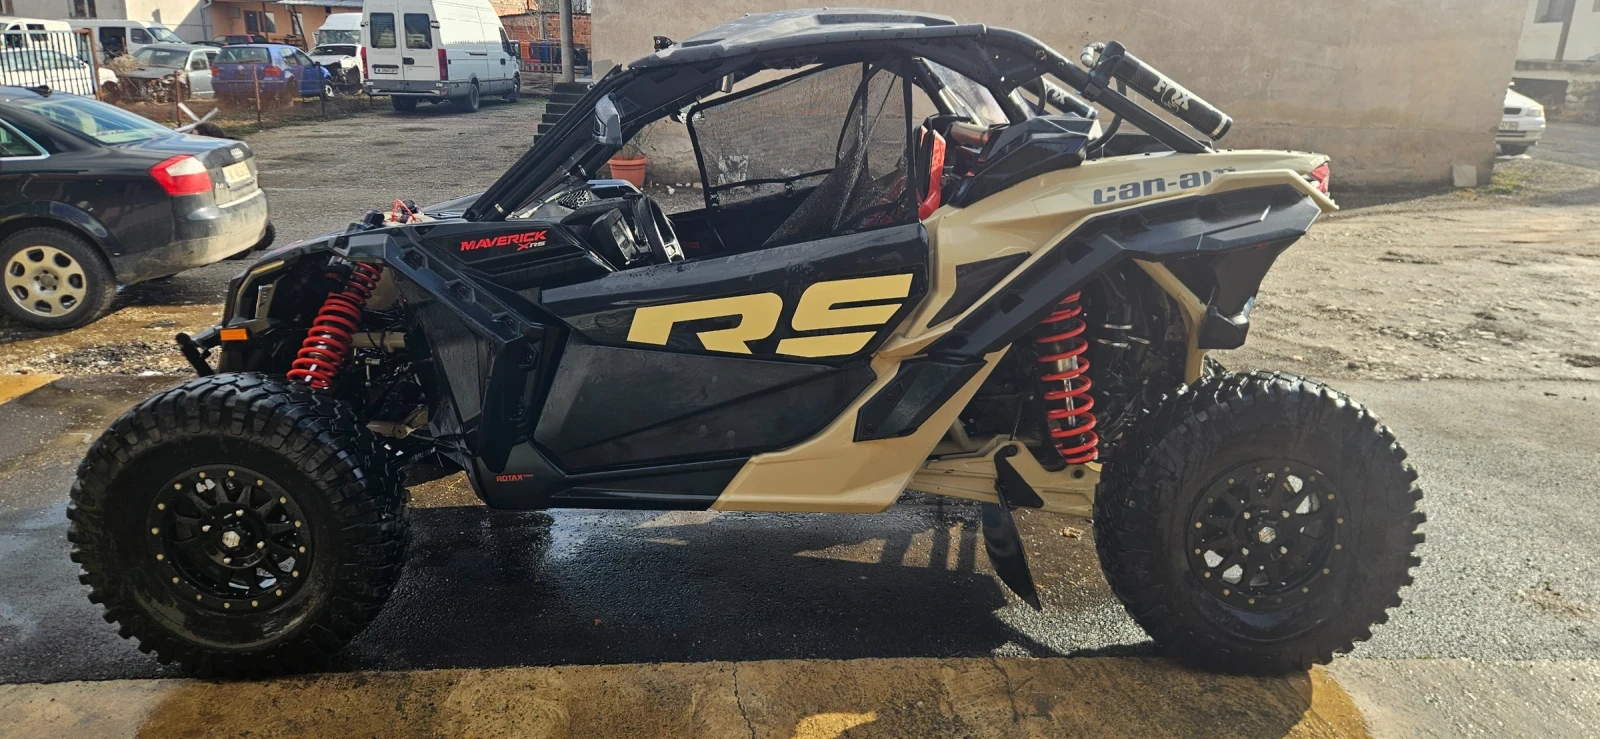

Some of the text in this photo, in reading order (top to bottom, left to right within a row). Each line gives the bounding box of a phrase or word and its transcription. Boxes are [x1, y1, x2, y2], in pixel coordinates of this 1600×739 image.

[1153, 77, 1190, 112] FOX
[460, 230, 547, 251] MAVERICK
[627, 273, 914, 358] RS
[496, 474, 523, 482] ROTAX
